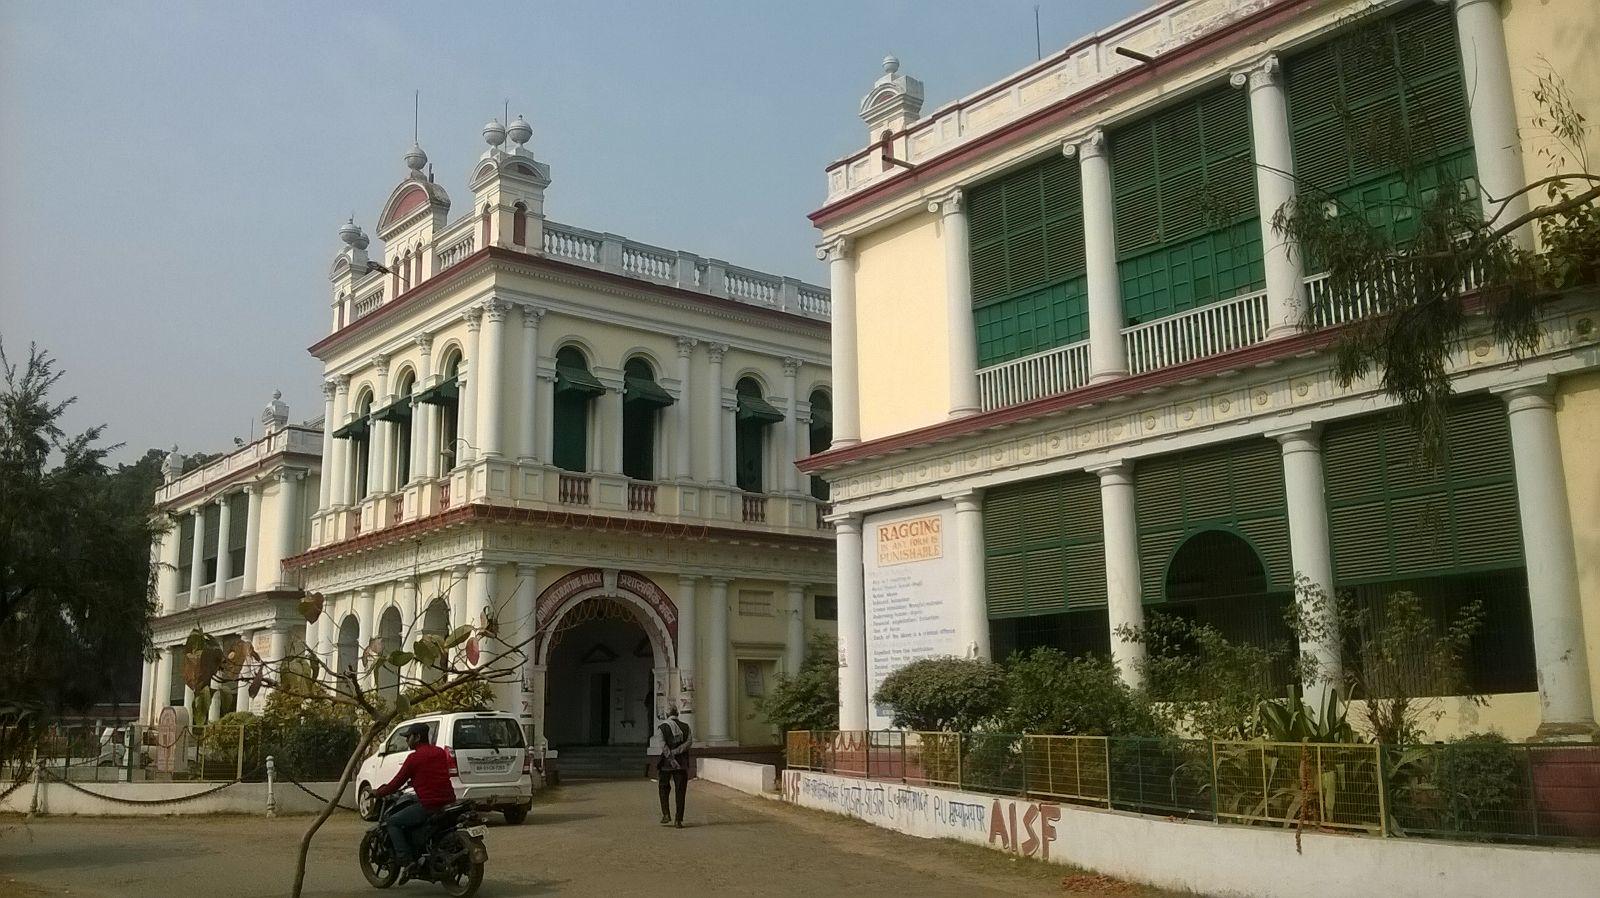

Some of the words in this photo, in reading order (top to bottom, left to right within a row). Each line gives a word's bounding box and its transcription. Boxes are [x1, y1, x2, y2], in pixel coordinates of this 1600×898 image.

[879, 518, 940, 542] RAGGING
[880, 545, 940, 563] PUNISHABLE
[581, 572, 602, 585] BLOCK
[989, 798, 1062, 861] AISF
